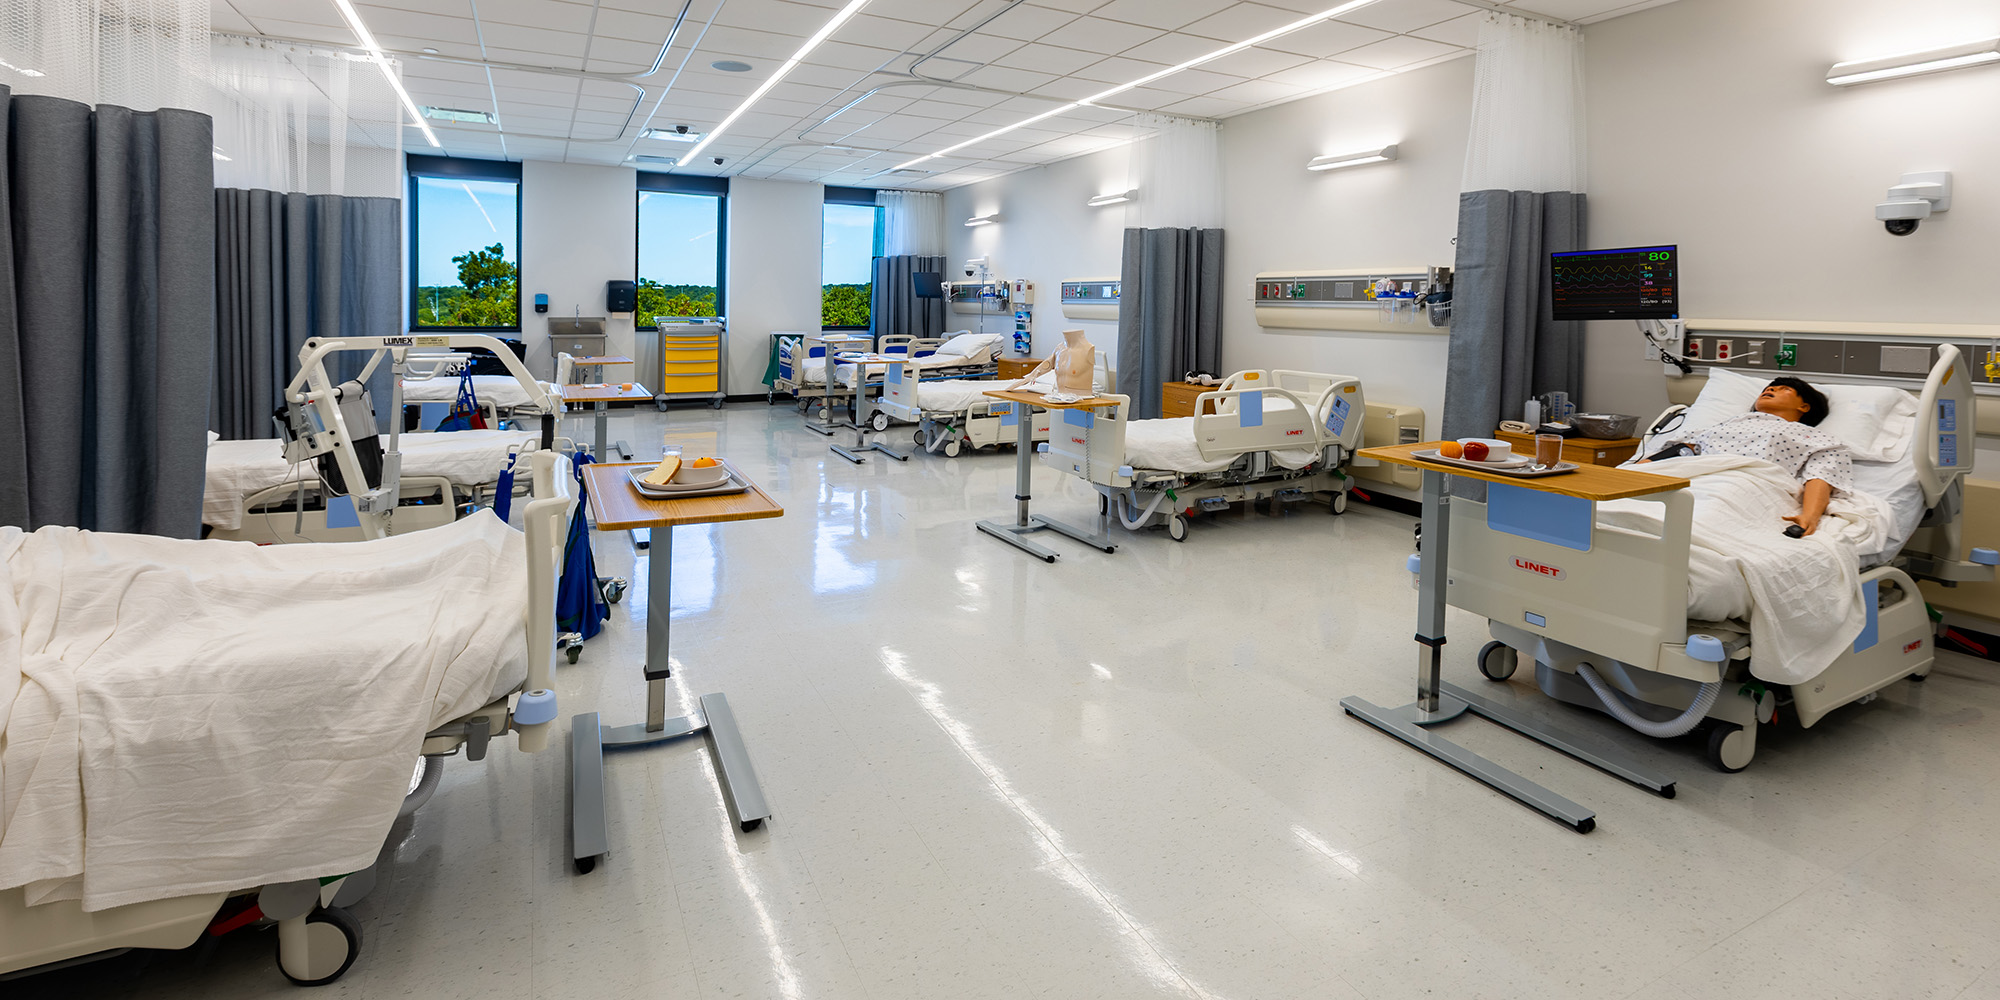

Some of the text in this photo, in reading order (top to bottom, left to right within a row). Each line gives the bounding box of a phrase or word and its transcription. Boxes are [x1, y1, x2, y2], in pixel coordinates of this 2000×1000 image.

[1648, 251, 1670, 261] 80
[383, 337, 413, 345] LUMEX
[1071, 437, 1085, 445] LINET
[1515, 558, 1560, 577] LINET
